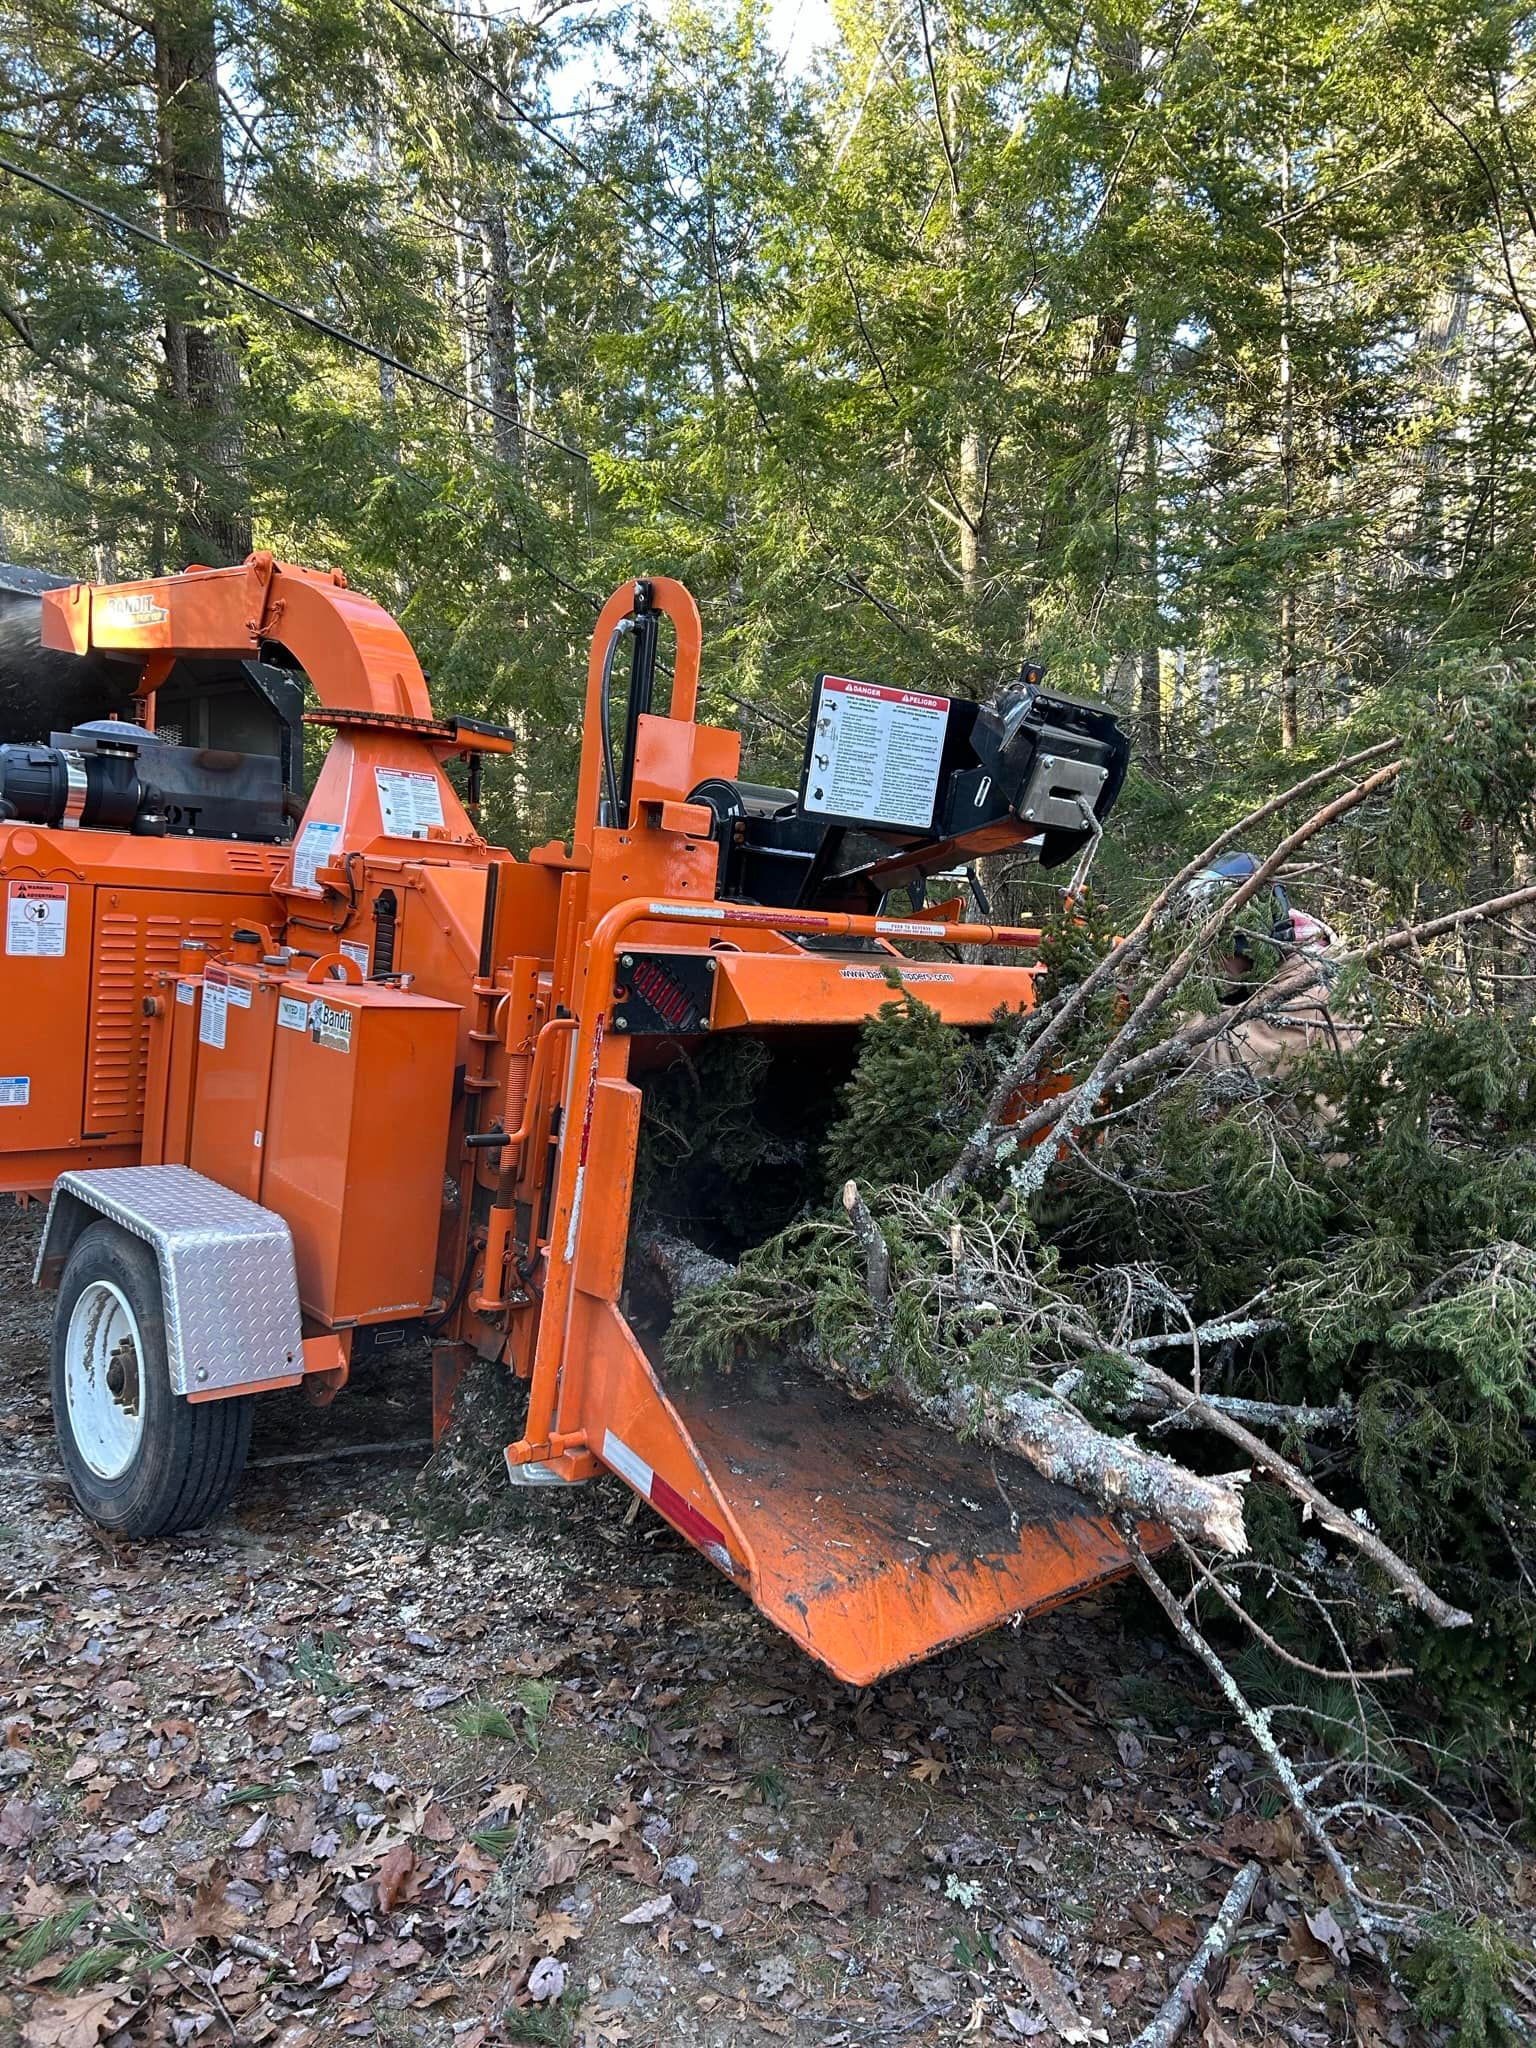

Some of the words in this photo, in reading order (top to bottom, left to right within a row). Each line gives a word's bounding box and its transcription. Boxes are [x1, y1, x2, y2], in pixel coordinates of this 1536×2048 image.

[853, 686, 881, 697] DANGER
[909, 696, 937, 707] PELIGRO
[164, 805, 203, 826] OT
[323, 1005, 352, 1032] Bandit
